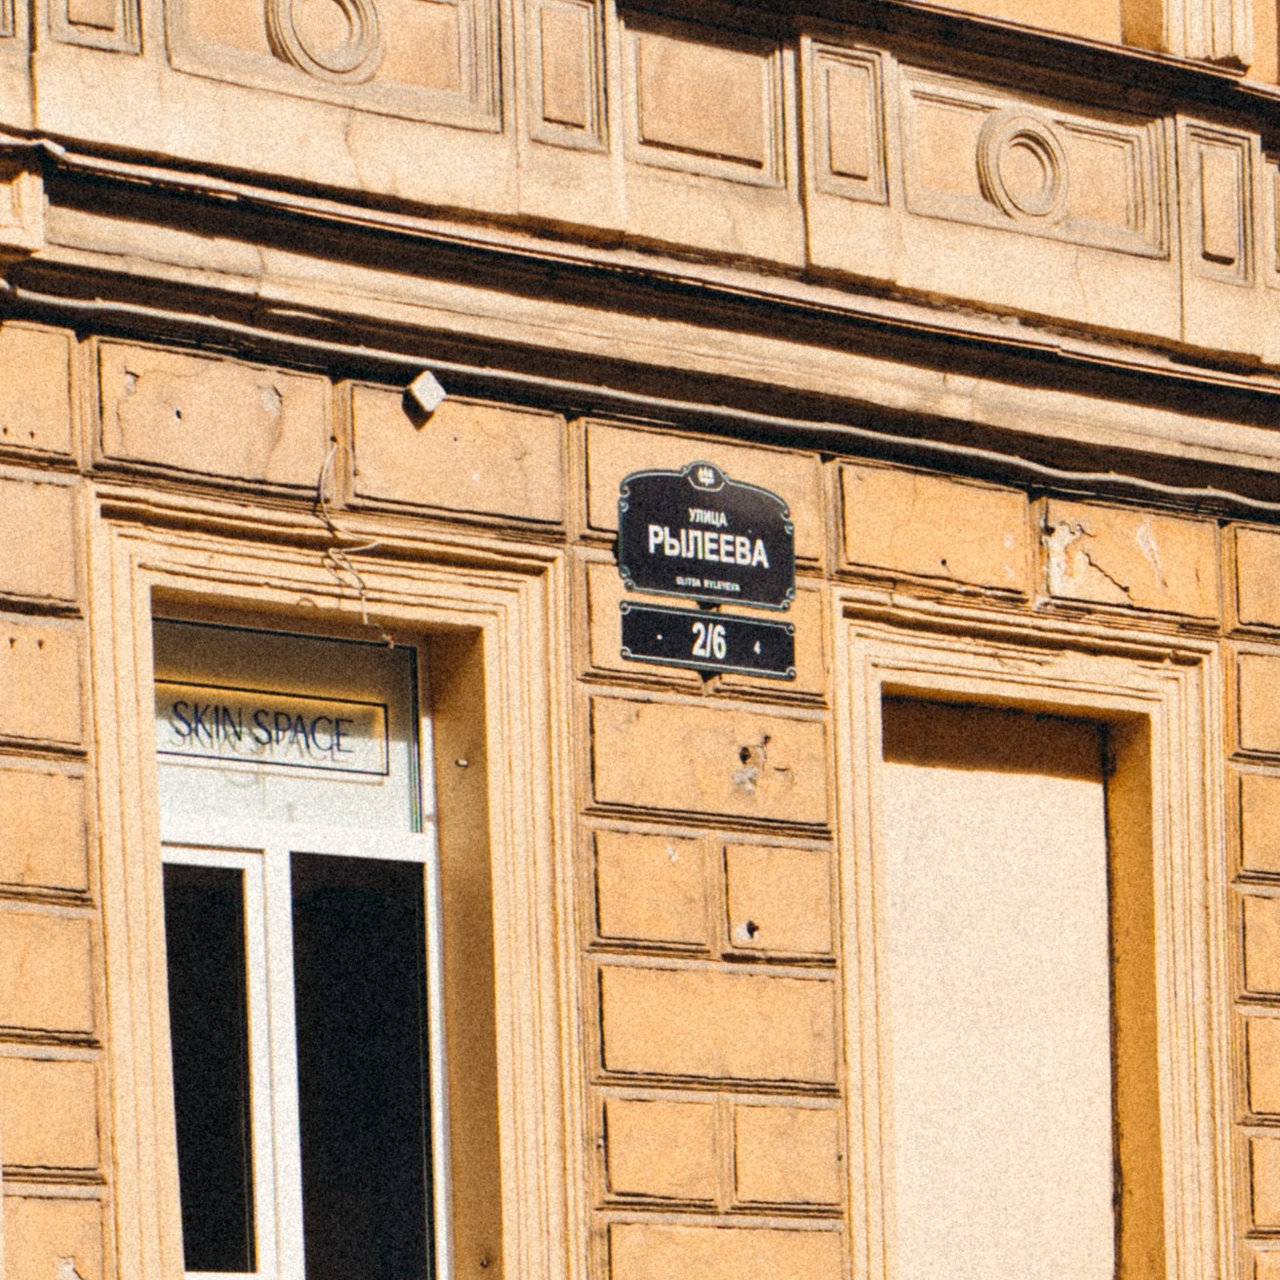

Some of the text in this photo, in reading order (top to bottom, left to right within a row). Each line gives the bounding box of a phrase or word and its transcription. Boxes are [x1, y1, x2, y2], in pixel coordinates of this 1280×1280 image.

[688, 507, 728, 527] УЛИЦА
[648, 524, 769, 569] РЫЛЕЕВА
[692, 621, 727, 660] 2/6
[172, 700, 355, 754] SKIN SPACE
